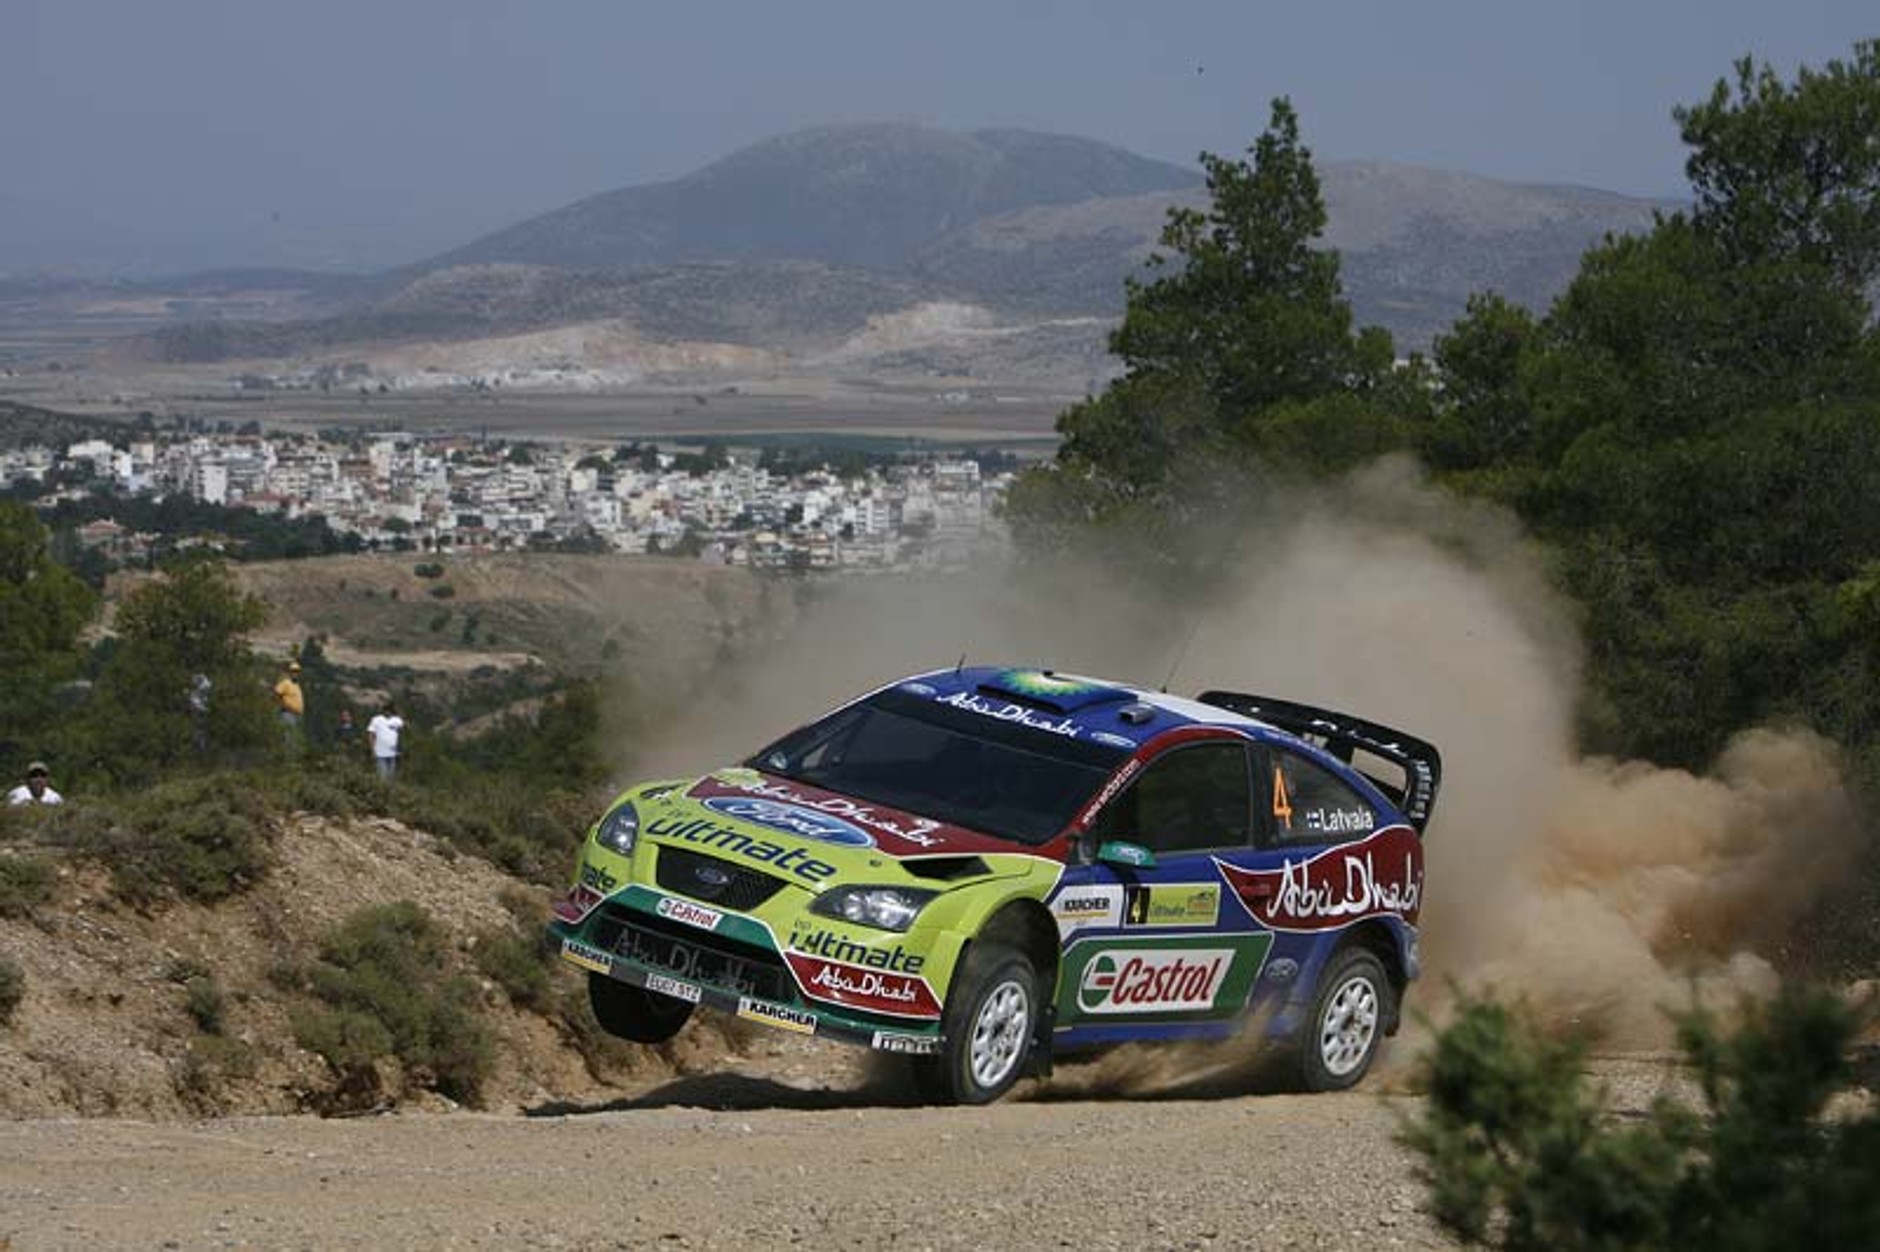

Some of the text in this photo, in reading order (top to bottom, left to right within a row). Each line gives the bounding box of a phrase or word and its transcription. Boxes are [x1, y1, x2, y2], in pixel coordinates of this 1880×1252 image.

[994, 704, 1084, 738] Dhabi
[1273, 767, 1292, 830] 4
[1319, 807, 1375, 831] Latvala
[645, 818, 837, 883] ultimate
[1266, 850, 1423, 918] Abu Dhabi
[789, 930, 926, 973] ultimate
[859, 973, 917, 1002] Dhabi
[1112, 956, 1222, 1005] Castrol
